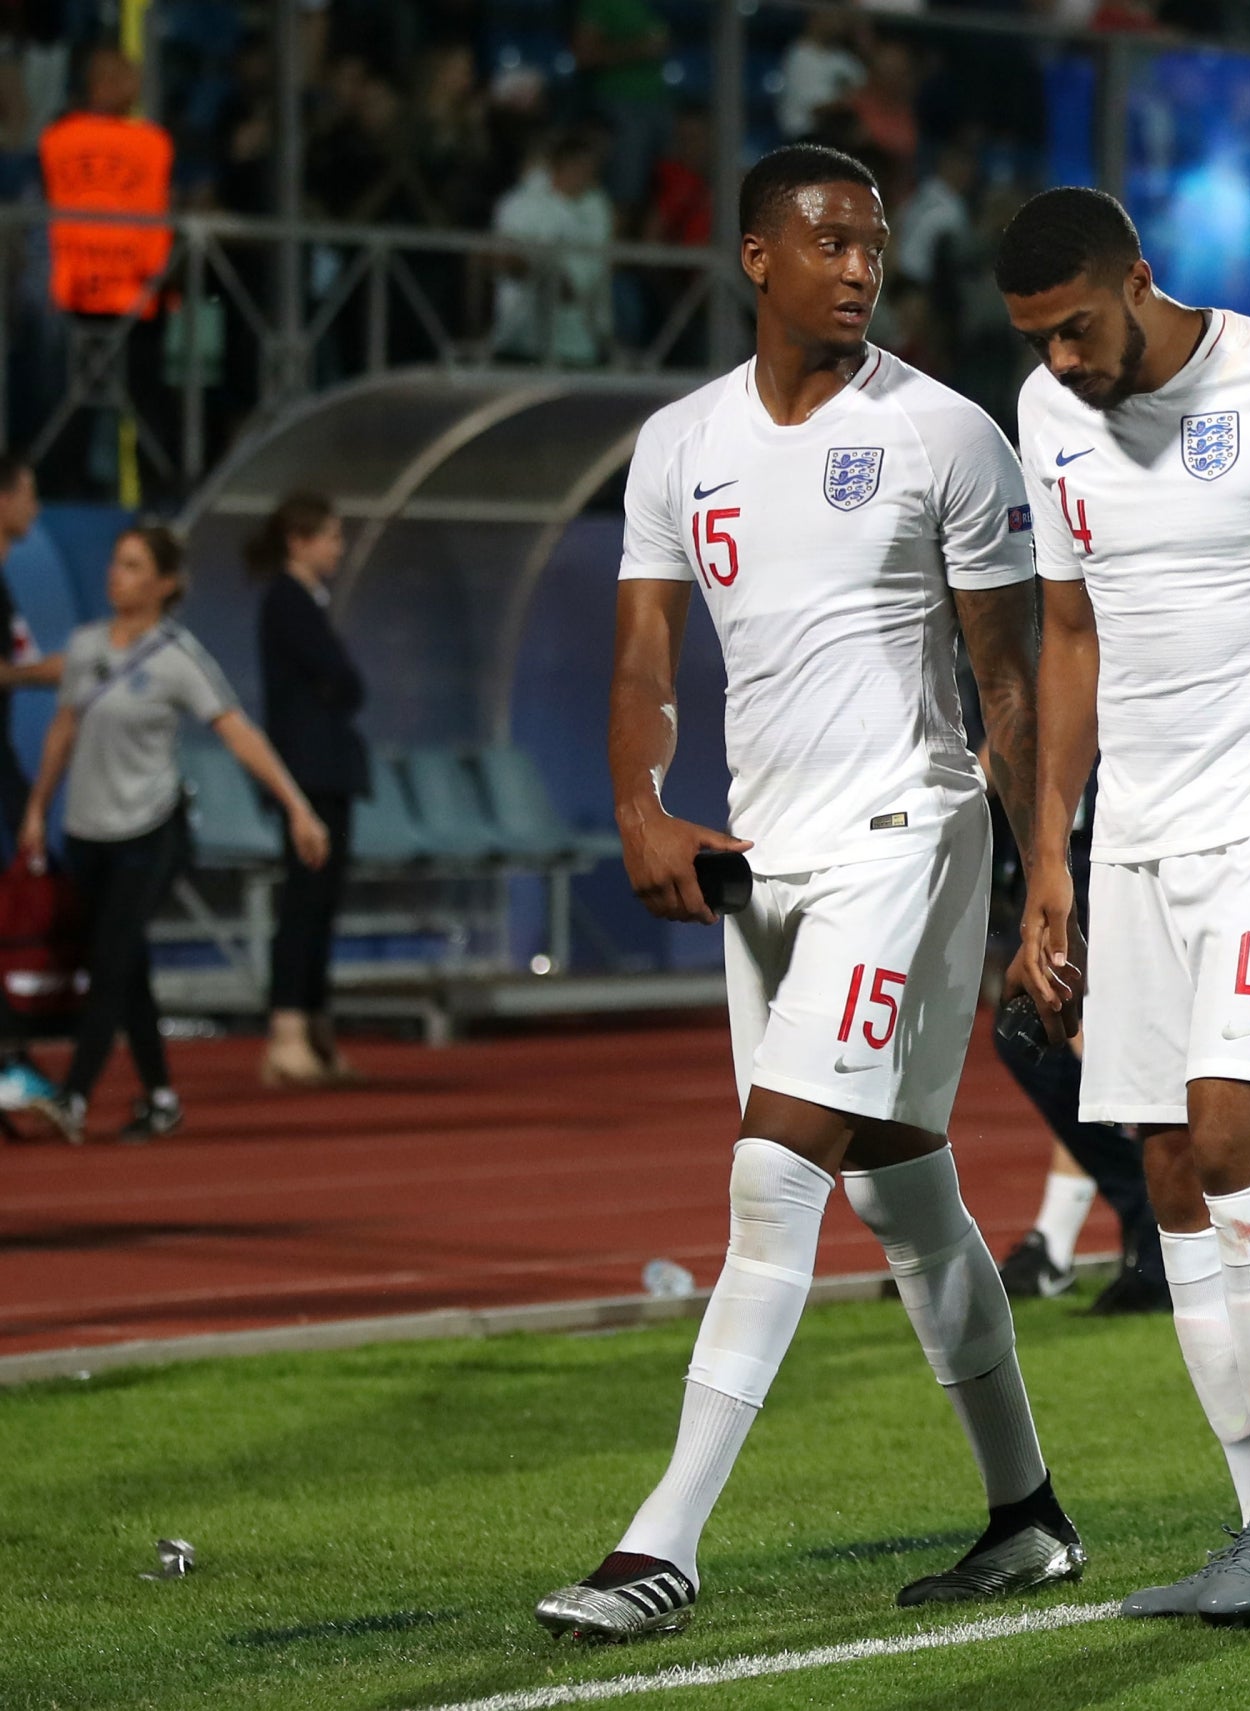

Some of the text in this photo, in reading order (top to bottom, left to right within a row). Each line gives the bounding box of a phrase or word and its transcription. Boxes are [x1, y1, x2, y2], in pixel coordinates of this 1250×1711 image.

[691, 507, 741, 589] 15
[1056, 476, 1093, 555] 4
[837, 964, 907, 1050] 15
